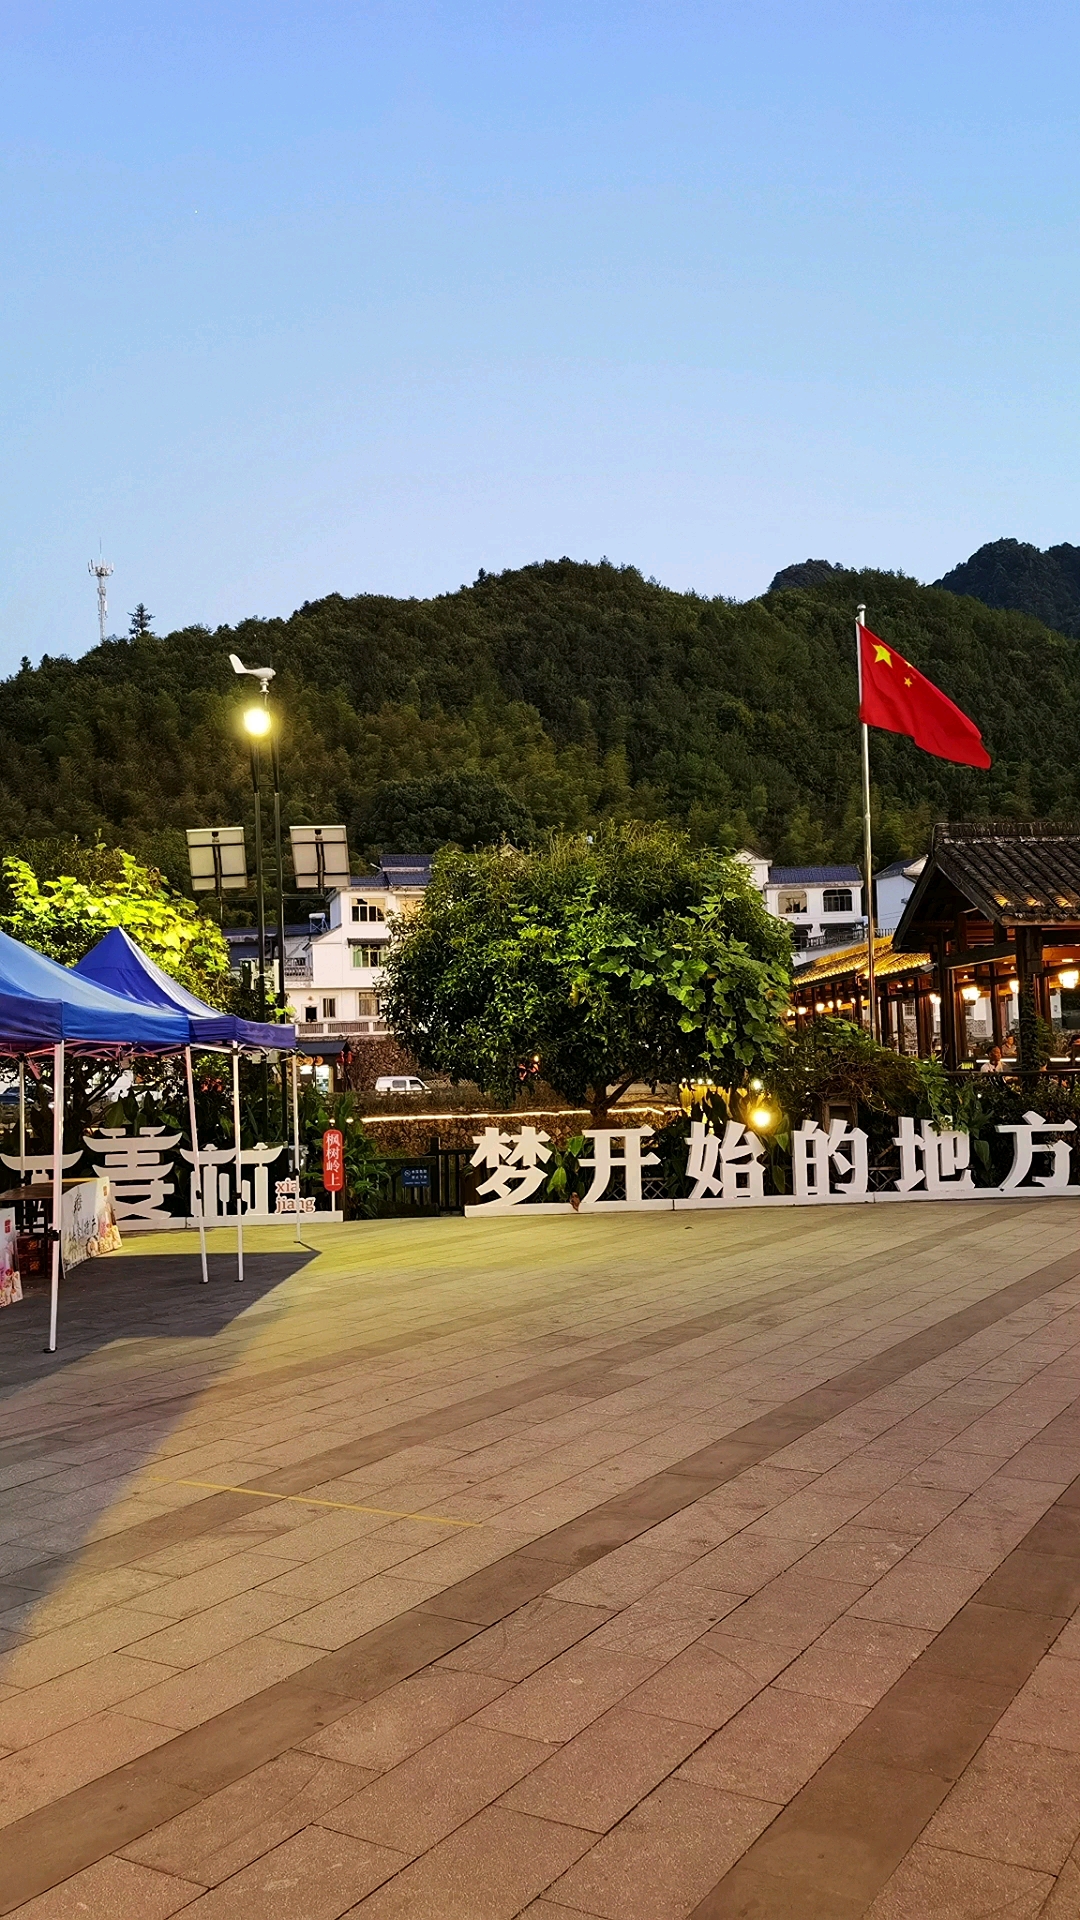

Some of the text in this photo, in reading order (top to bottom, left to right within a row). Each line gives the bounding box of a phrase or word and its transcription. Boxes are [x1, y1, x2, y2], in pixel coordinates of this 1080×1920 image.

[326, 1133, 340, 1186] 枫树岭上
[470, 1111, 1077, 1205] 梦开始的地方
[276, 1178, 299, 1193] xia
[276, 1196, 315, 1213] jiang
